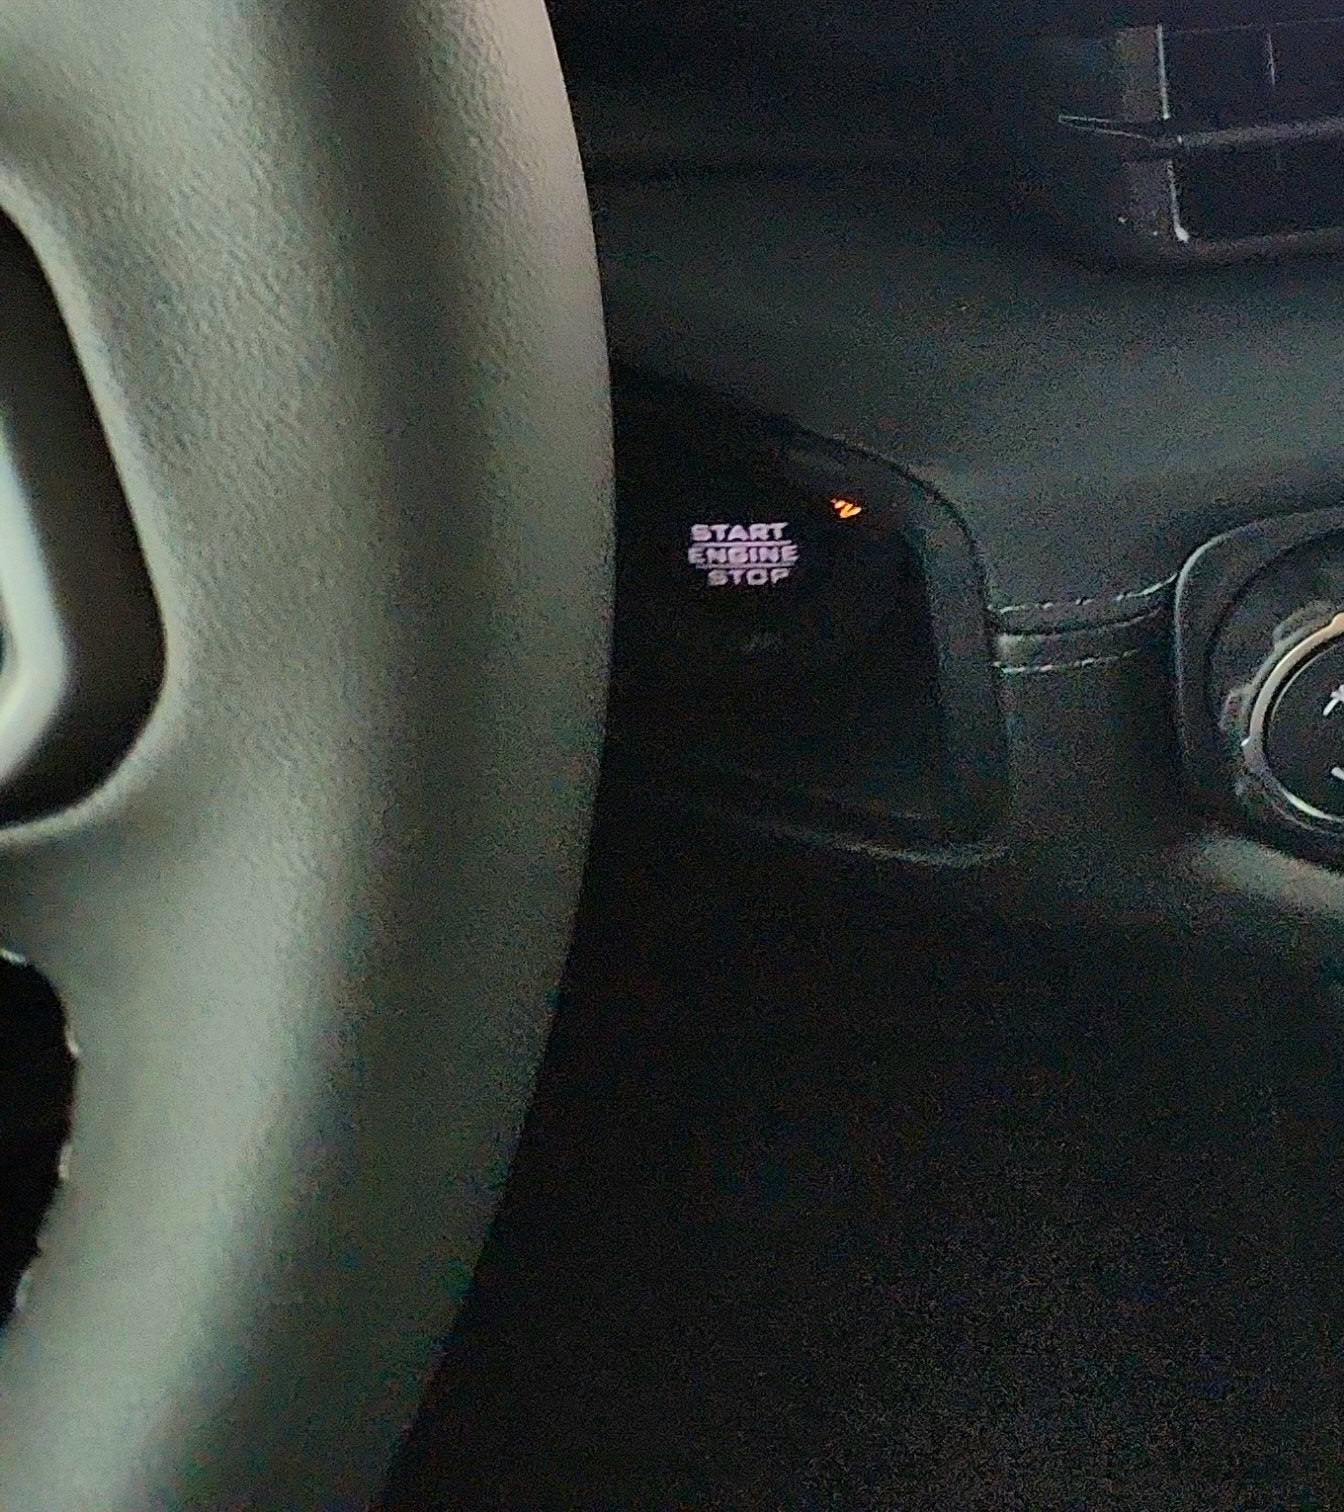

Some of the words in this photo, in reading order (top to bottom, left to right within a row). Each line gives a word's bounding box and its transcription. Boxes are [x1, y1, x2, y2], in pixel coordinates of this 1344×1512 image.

[691, 522, 790, 541] START
[688, 544, 799, 564] ENGINE
[708, 567, 791, 586] STOP
